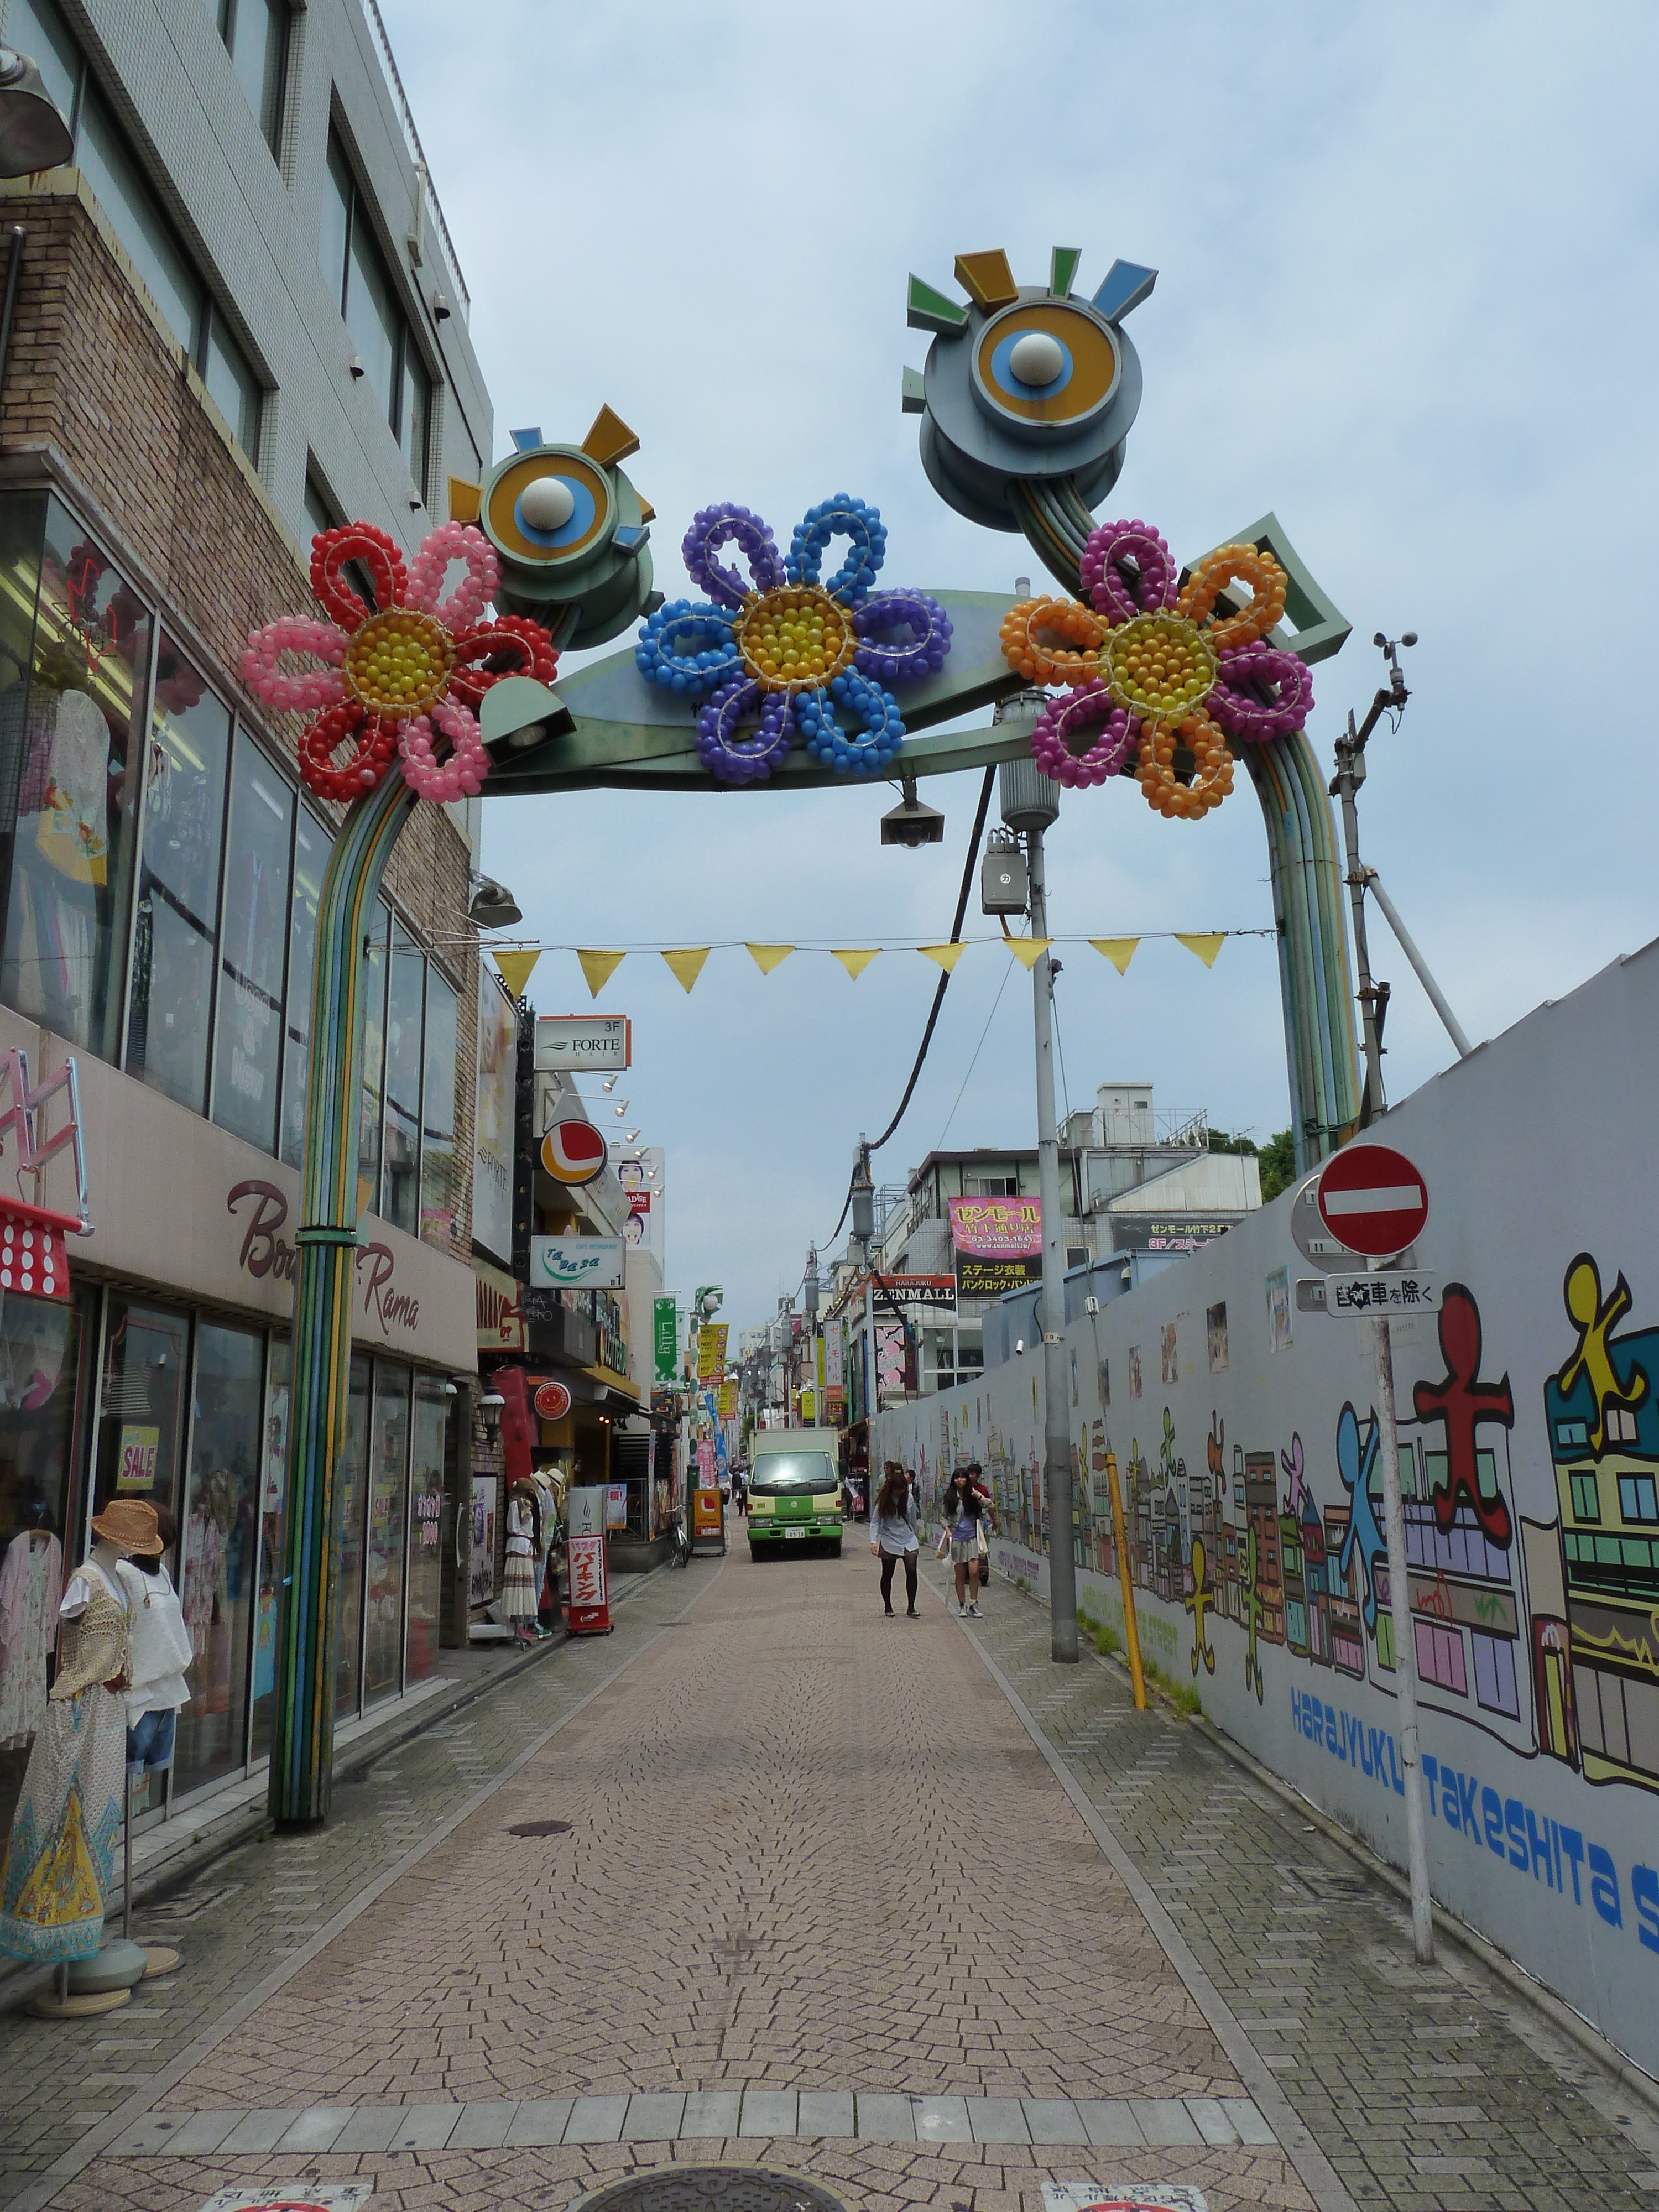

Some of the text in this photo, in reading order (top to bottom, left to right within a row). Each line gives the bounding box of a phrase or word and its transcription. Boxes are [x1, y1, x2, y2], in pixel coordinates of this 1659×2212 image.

[604, 1022, 620, 1032] 3F
[572, 1038, 620, 1051] FORTE
[954, 1206, 1040, 1223] ゼンモール
[965, 1223, 1035, 1234] 竹下通り店
[962, 1264, 1026, 1276] ステージ衣装
[611, 1274, 621, 1286] B1
[1336, 1279, 1433, 1310] 自車を除く
[658, 1321, 673, 1354] Lilly
[831, 1326, 839, 1381] ゼンモール
[122, 1446, 155, 1478] SALE
[572, 1552, 598, 1601] バイキング
